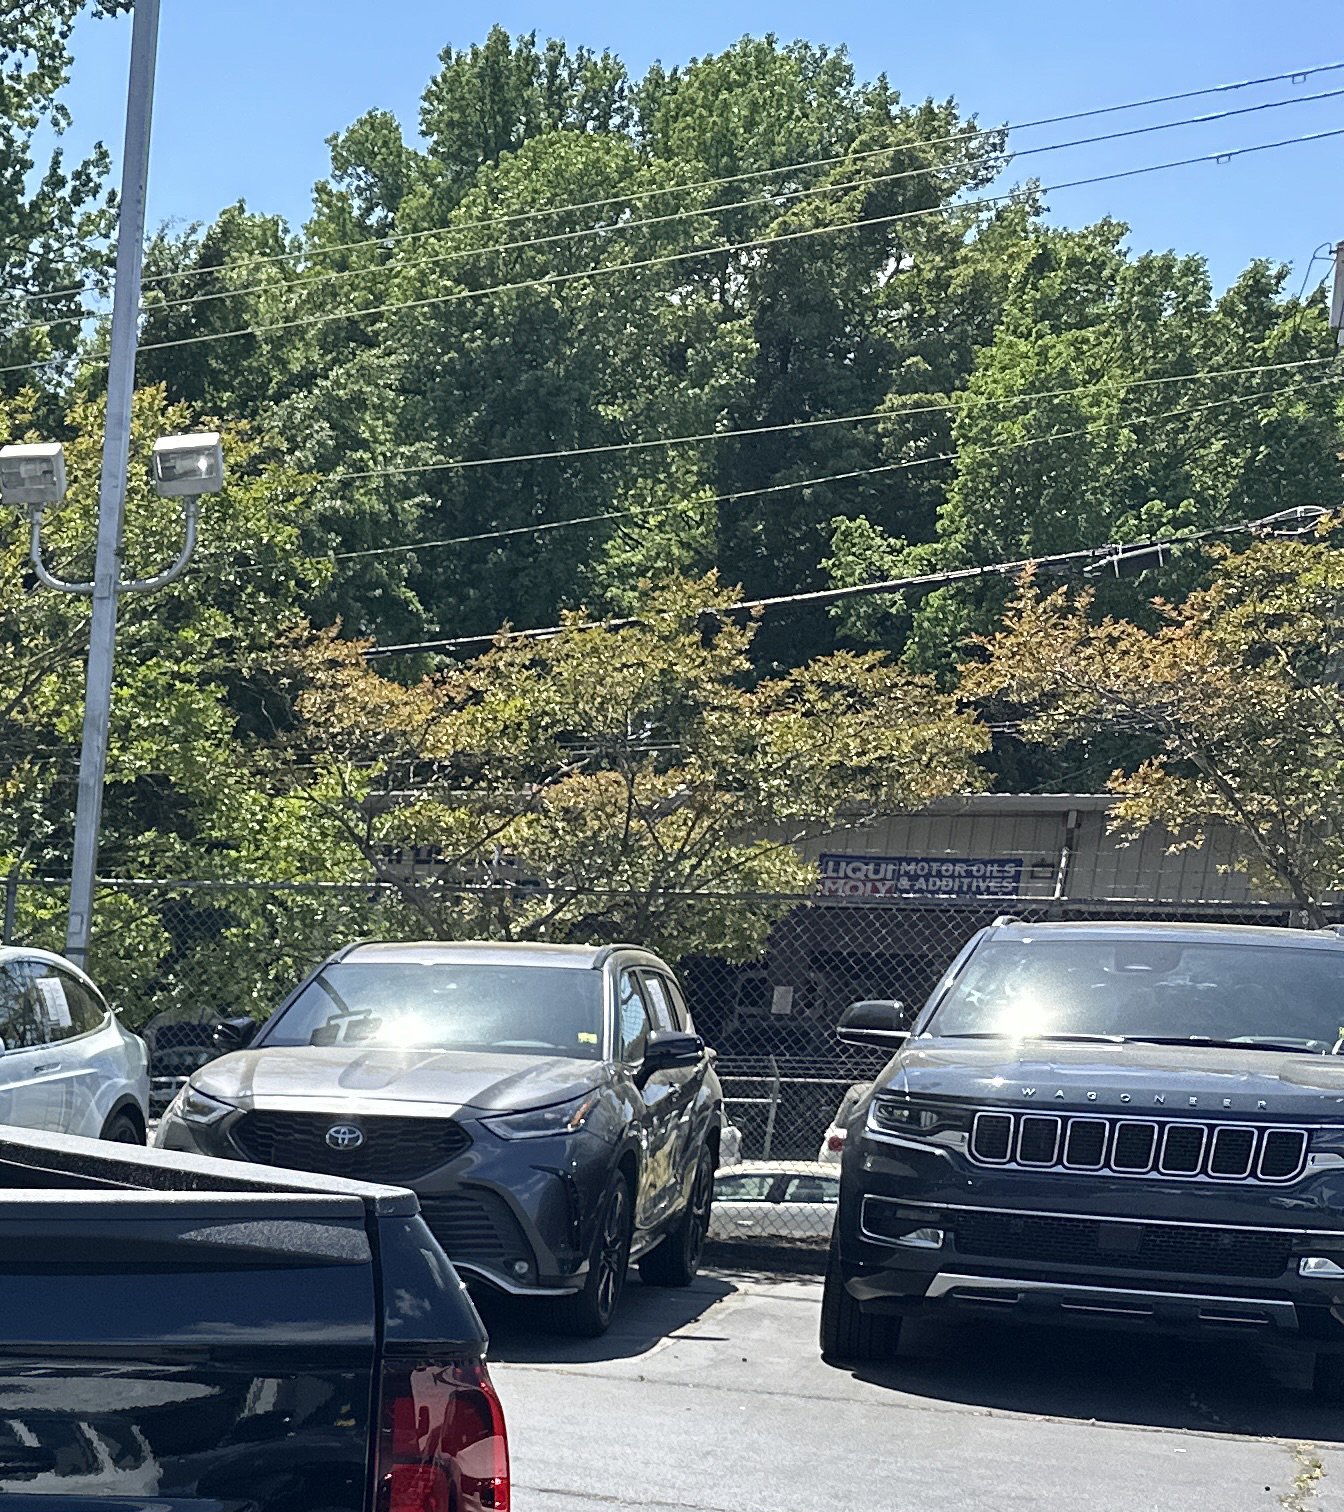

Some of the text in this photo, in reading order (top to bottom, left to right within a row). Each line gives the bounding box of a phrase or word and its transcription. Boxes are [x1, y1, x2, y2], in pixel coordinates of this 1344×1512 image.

[826, 861, 895, 880] LIQUI
[900, 861, 1017, 877] MOTOR OILS
[823, 880, 894, 895] MOLY
[897, 877, 1014, 893] & ADDITIVES
[1021, 1087, 1267, 1110] WAGONEER
